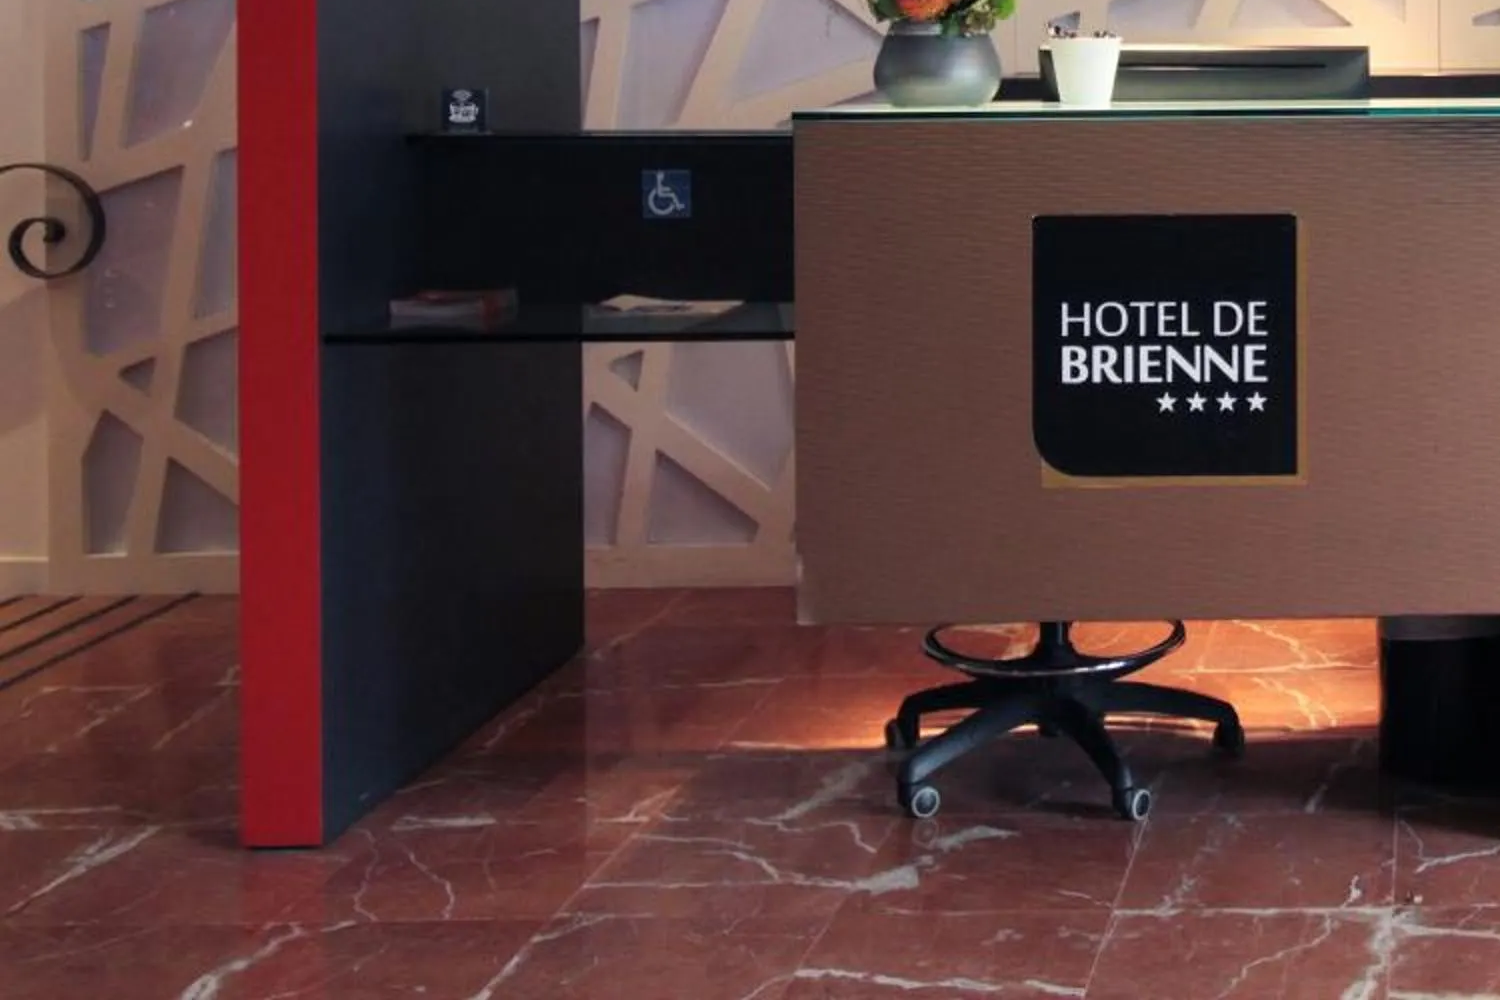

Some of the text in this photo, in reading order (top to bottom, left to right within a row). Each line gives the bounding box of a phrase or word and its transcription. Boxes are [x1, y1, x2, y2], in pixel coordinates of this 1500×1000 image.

[1060, 300, 1269, 338] HOTEL DE
[1060, 344, 1269, 385] BRIENNE
